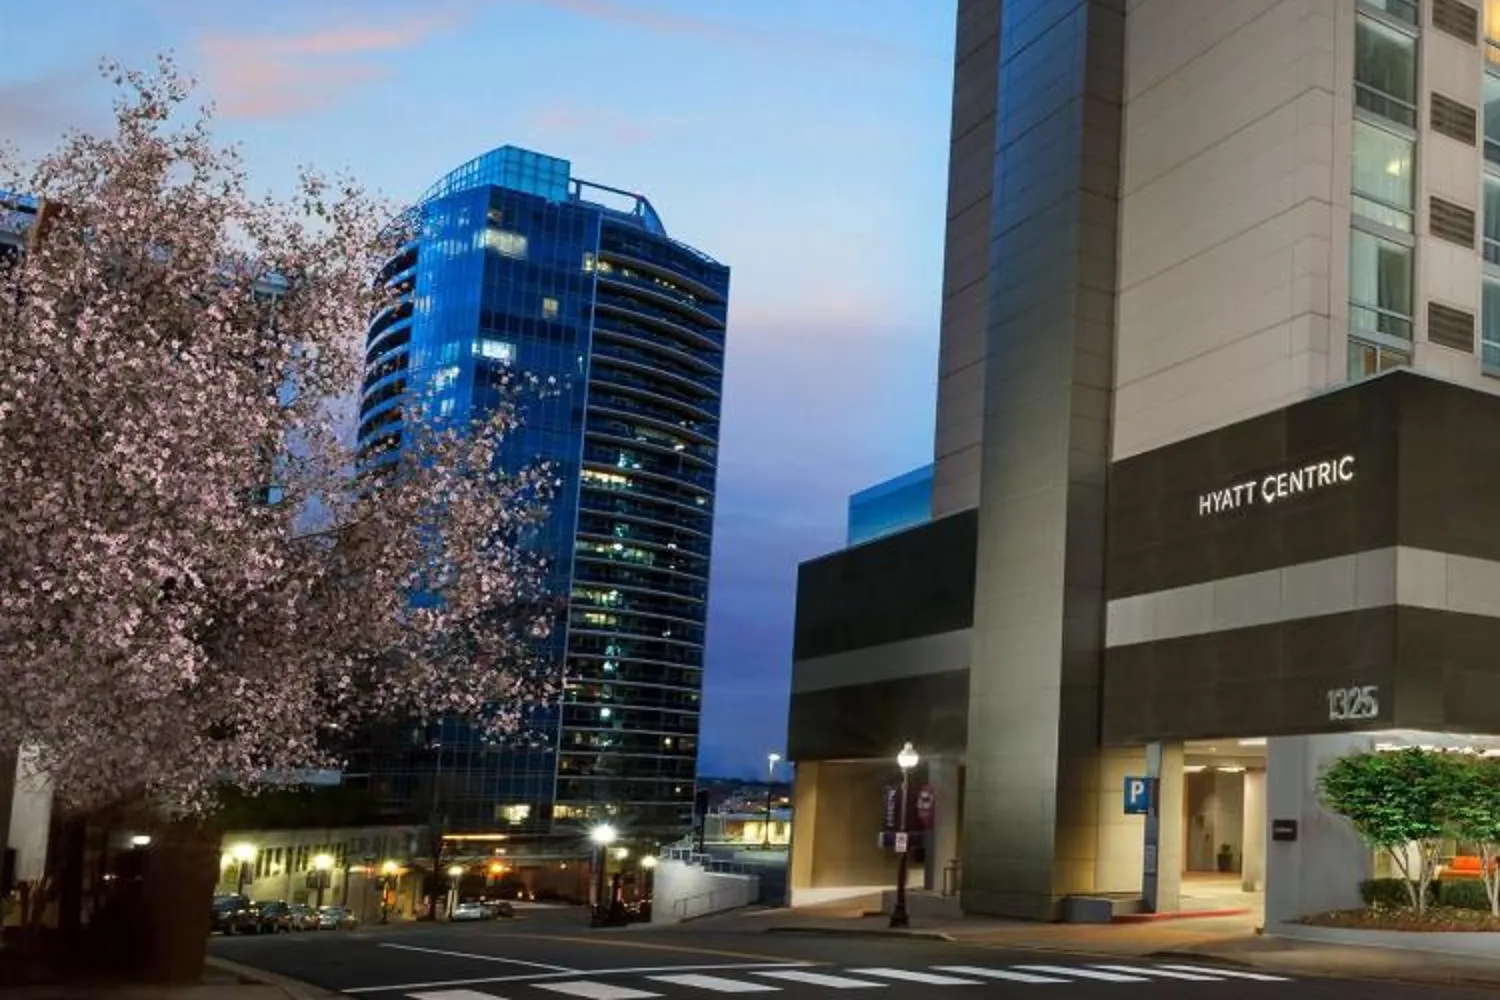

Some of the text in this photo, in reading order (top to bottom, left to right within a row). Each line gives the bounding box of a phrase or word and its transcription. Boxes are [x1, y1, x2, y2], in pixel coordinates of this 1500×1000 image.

[1199, 455, 1355, 516] HYATT CENTRIC
[1328, 686, 1379, 720] 1325
[1131, 780, 1145, 804] P
